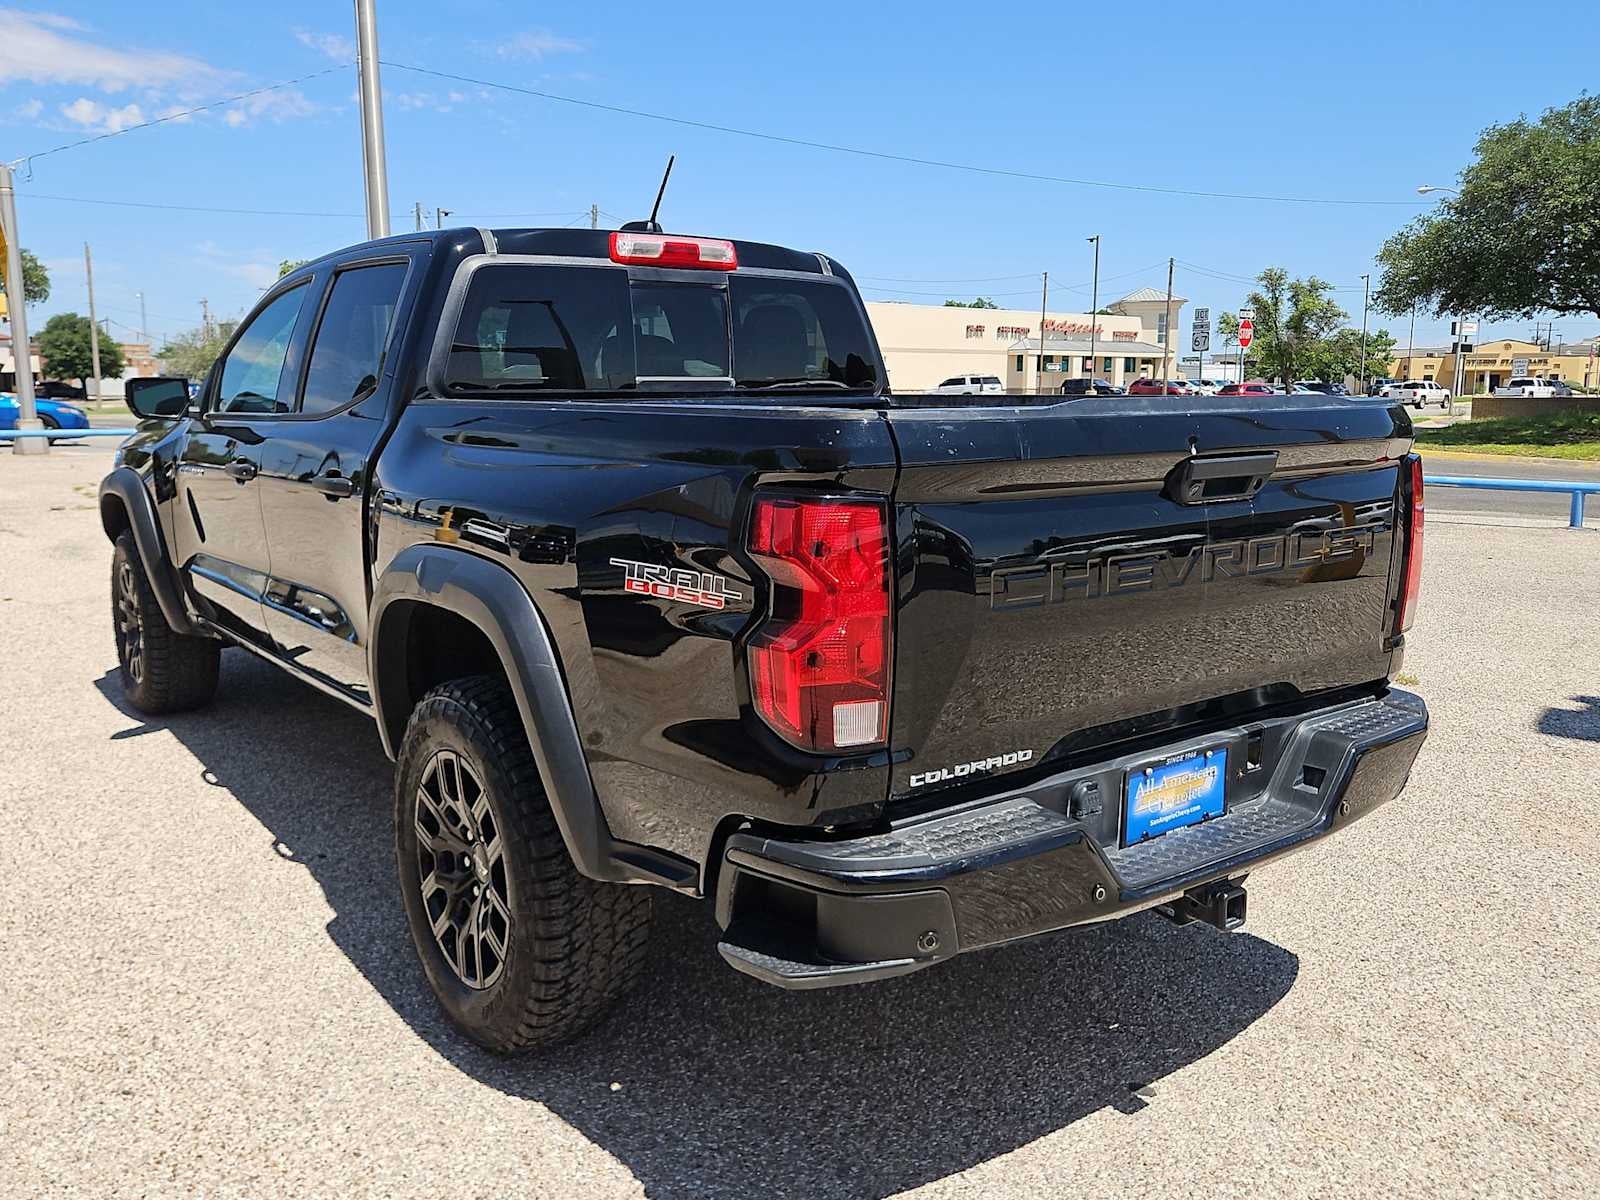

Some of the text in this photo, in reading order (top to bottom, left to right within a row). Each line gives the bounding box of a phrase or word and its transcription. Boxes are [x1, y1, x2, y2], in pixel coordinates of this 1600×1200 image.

[1194, 335, 1208, 347] 67
[1239, 328, 1253, 340] STOP
[609, 557, 742, 600] TRAIL
[991, 521, 1385, 611] CHEVROLET
[625, 578, 724, 609] BOSS
[909, 749, 1033, 788] COLORADO
[1166, 754, 1185, 765] SINCE
[1135, 777, 1155, 799] All
